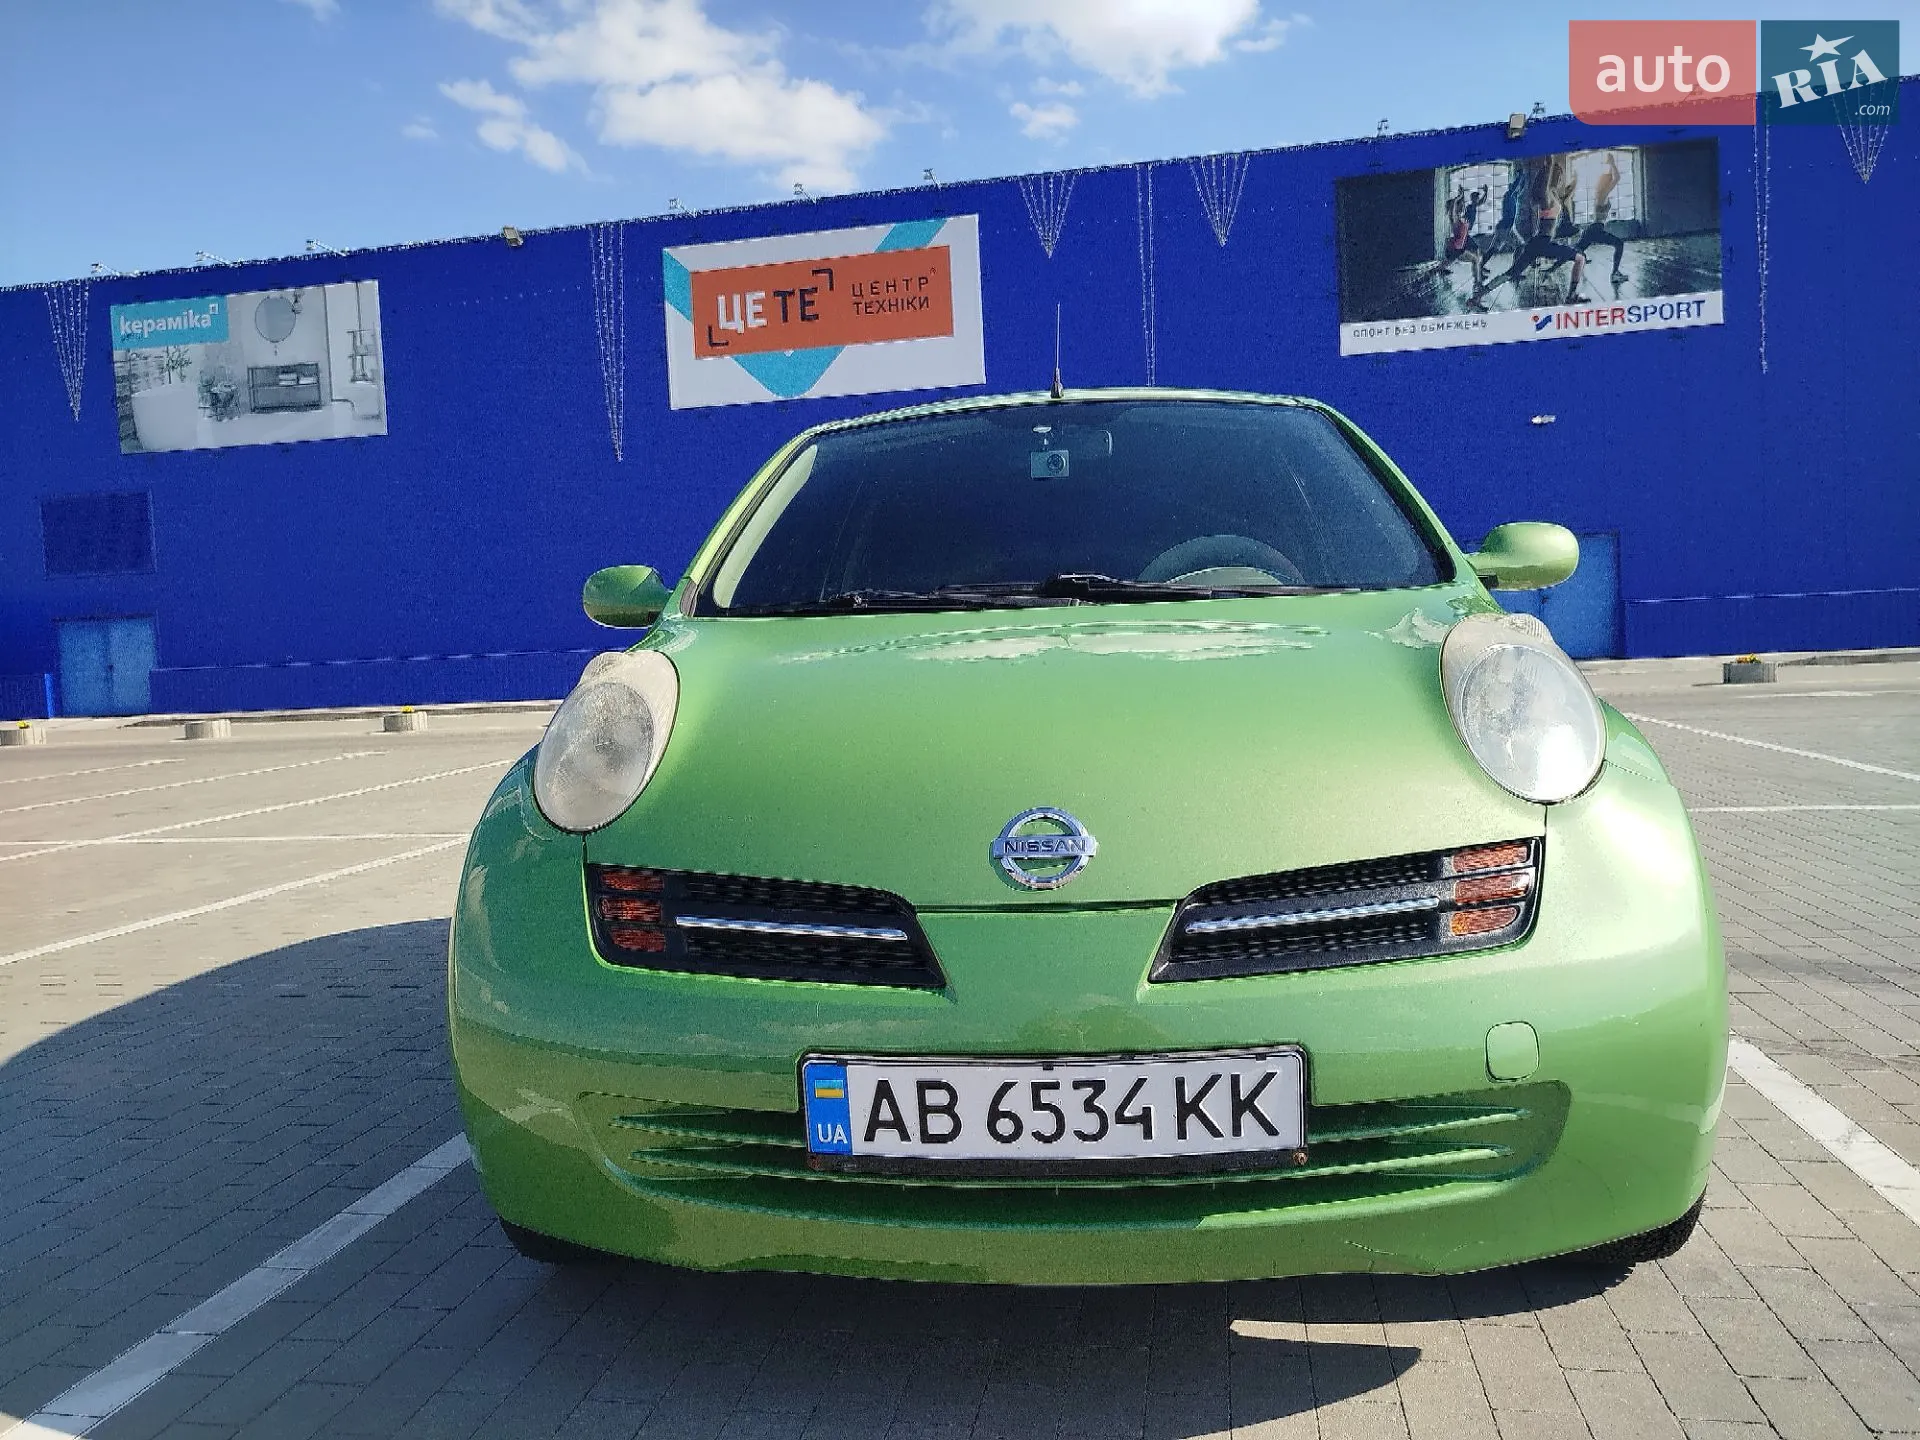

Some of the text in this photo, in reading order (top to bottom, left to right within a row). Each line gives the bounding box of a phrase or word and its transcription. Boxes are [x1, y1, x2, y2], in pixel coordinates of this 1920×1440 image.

[852, 276, 929, 298] ЦЕНТР
[717, 287, 819, 334] ЦЕ ТЕ
[853, 296, 930, 316] ТЕХНІКИ
[1555, 300, 1706, 330] INTERSPORT
[1394, 325, 1417, 336] БЕЗ
[1004, 839, 1086, 854] NISSAN
[863, 1071, 1281, 1145] AB 6534 KK
[817, 1122, 849, 1145] UA
